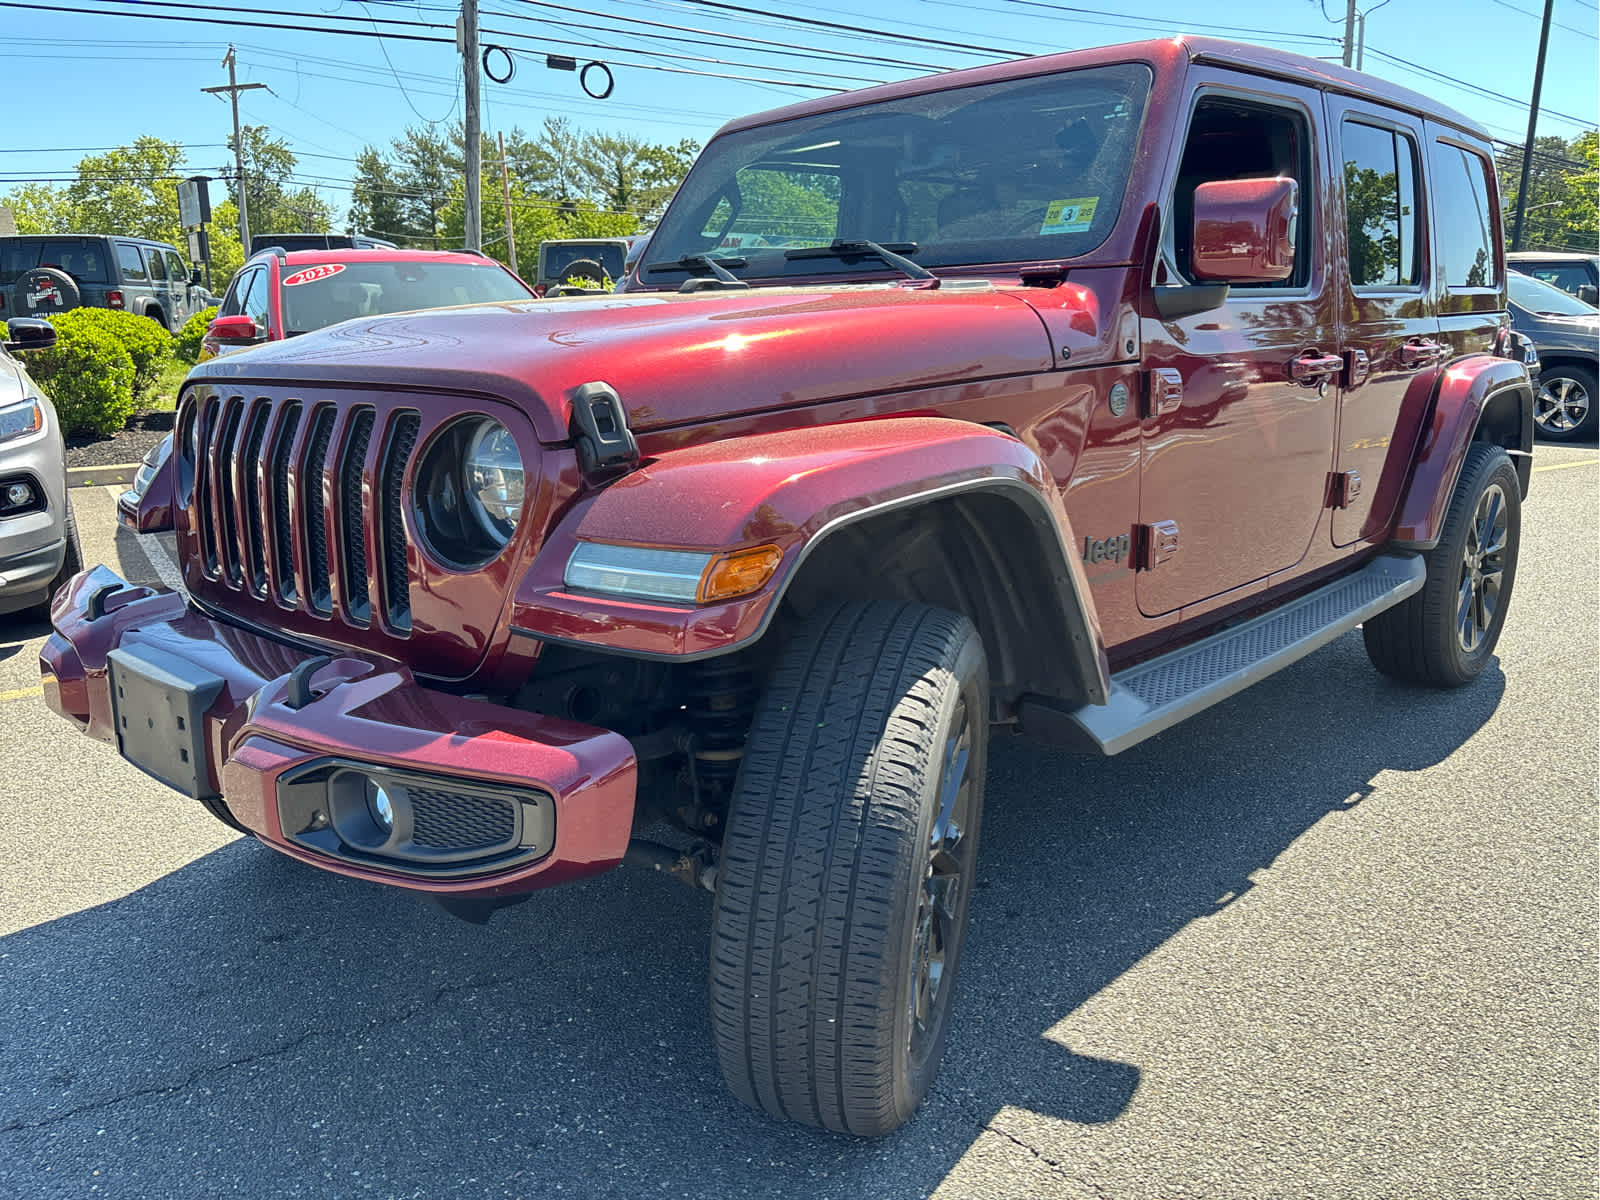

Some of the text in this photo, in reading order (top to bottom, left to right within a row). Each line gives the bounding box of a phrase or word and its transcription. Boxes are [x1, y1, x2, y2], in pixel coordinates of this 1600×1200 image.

[1063, 208, 1074, 221] 3
[296, 264, 335, 284] 2023
[1080, 534, 1129, 567] Jeep
